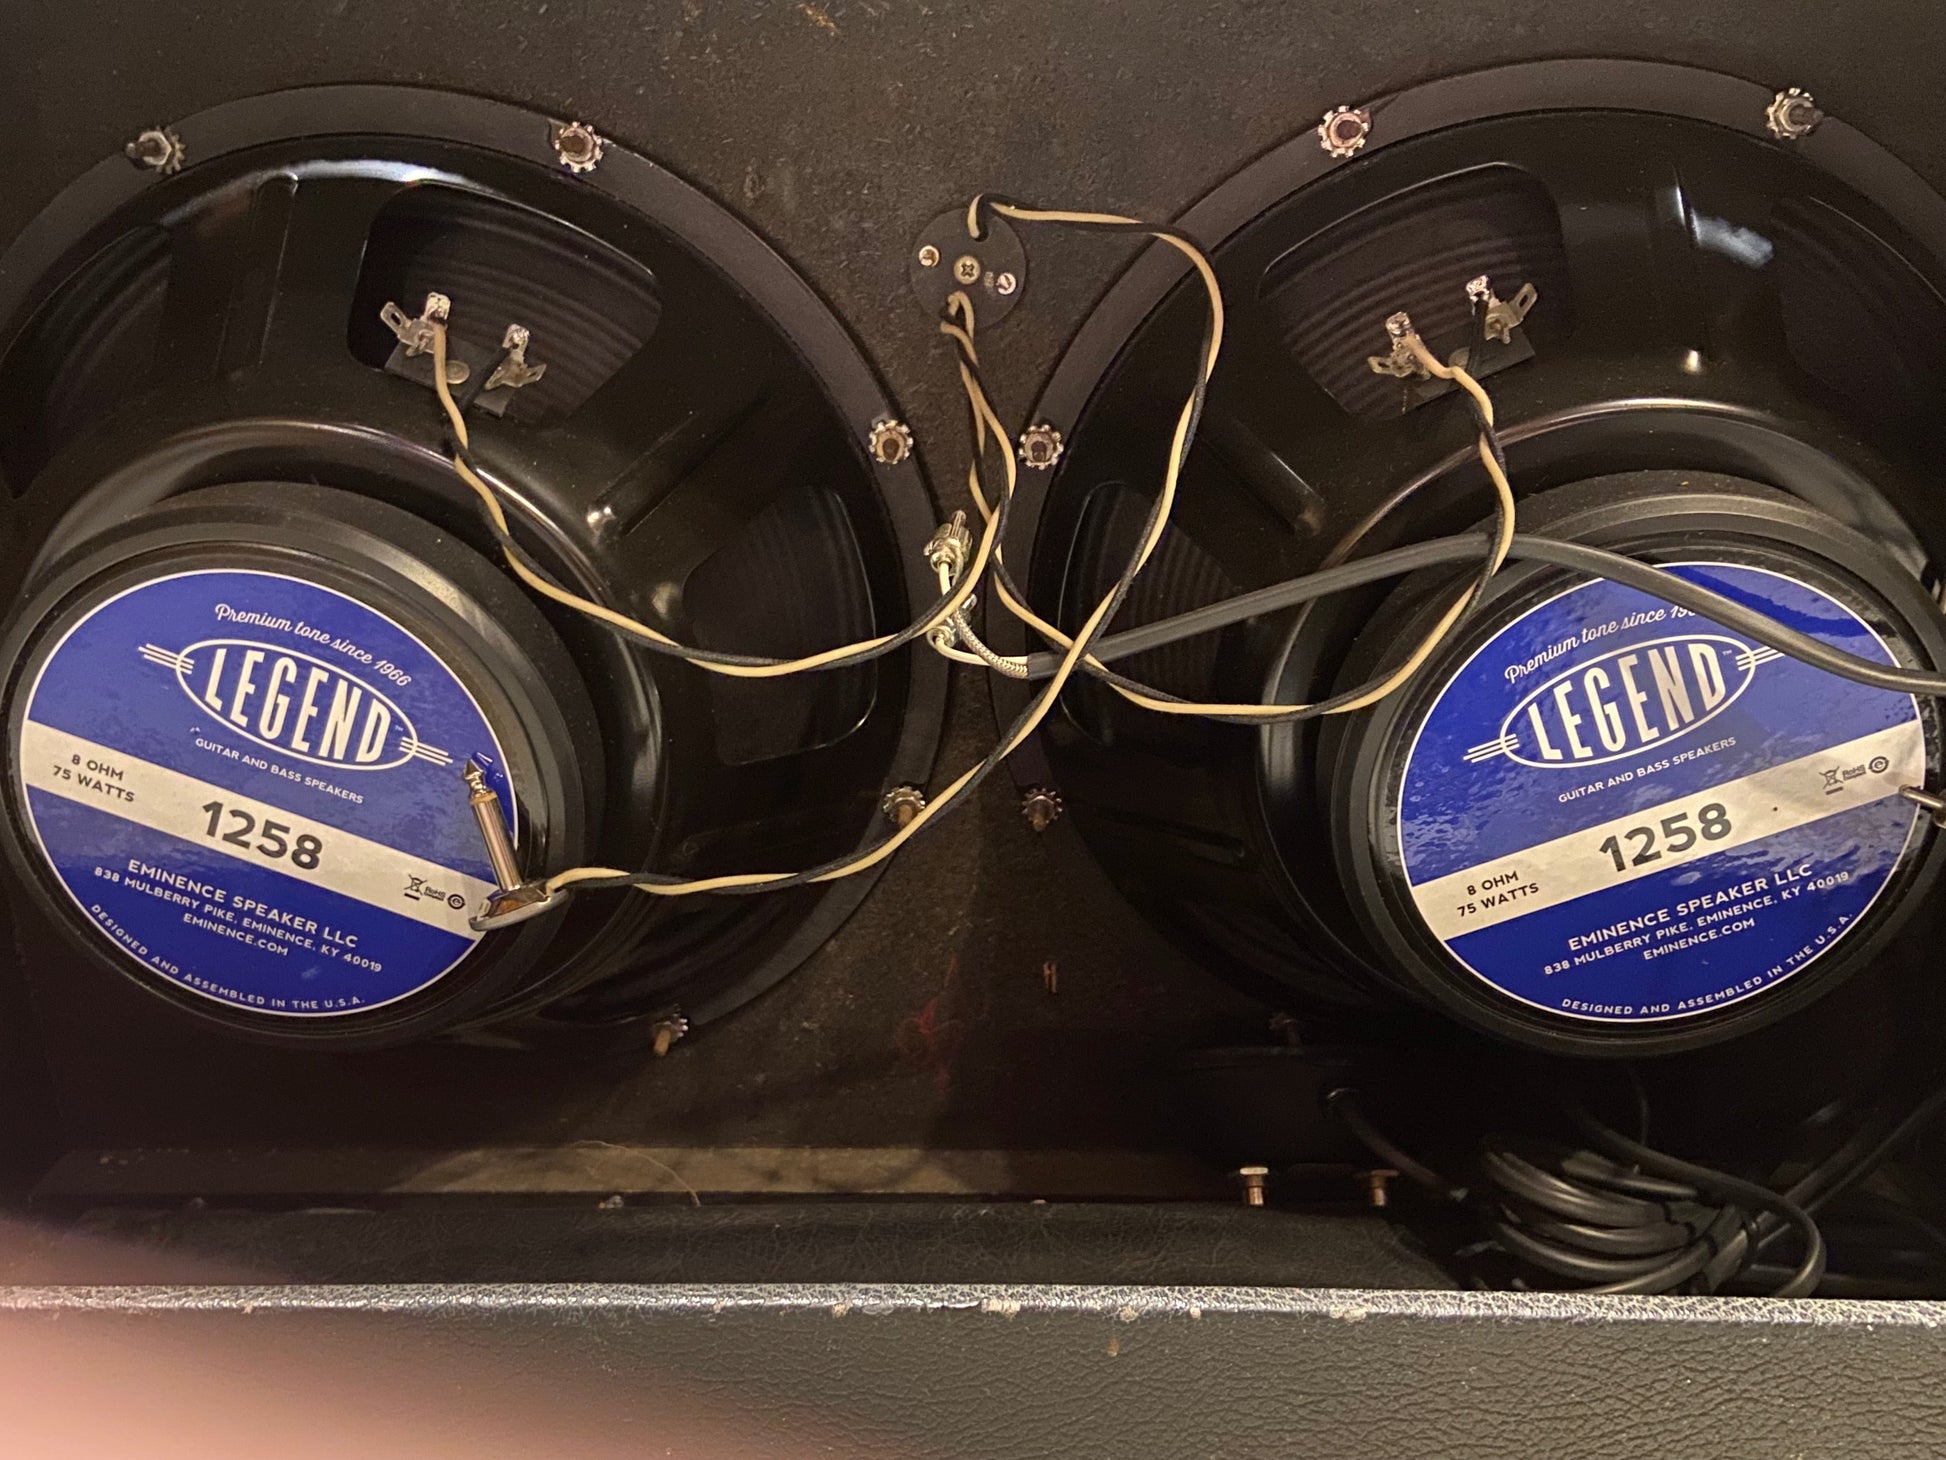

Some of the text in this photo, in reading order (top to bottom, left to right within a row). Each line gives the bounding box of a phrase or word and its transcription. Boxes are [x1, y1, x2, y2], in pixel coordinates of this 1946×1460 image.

[215, 604, 412, 687] Premium tone since 1966
[1505, 637, 1579, 683] Premium
[1581, 620, 1620, 642] tone
[1621, 609, 1666, 630] since
[205, 648, 391, 762] LEGEND
[1527, 643, 1726, 760] LEGEND
[53, 765, 135, 802] 75 WATTS
[71, 754, 124, 781] 8 OHM
[195, 738, 364, 804] GUITAR AND BASS SPEAKERS
[1558, 737, 1737, 803] GUITAR AND BASS SPEAKERS
[202, 801, 323, 870] 1258
[1599, 803, 1731, 872] 1258
[128, 859, 358, 948] EMINENCE SPEAKER LLC
[1457, 883, 1539, 917] 75 WATTS
[1467, 871, 1519, 896] 8 OHM
[1568, 864, 1813, 951] EMINENCE SPEAKER LLC
[94, 867, 120, 882] 838
[124, 876, 200, 909] MULBERRY
[321, 944, 340, 958] KY
[344, 953, 382, 973] 40019
[183, 913, 288, 956] EMINENCE.COM
[1544, 960, 1570, 975] 838
[1574, 934, 1651, 966] MULBERRY
[1782, 886, 1801, 900] KY
[1807, 871, 1849, 891] 40019
[1643, 918, 1755, 960] EMINENCE.COM
[91, 904, 148, 955] DESIGNED
[151, 955, 179, 974] AND
[184, 974, 264, 1005] ASSEMBLED
[272, 998, 285, 1007] IN
[292, 1000, 318, 1009] THE
[1562, 999, 1633, 1015] DESIGNED
[1640, 1003, 1670, 1014] AND
[1677, 976, 1762, 1010] ASSEMBLED
[1767, 966, 1783, 977] IN
[1786, 946, 1813, 966] THE
